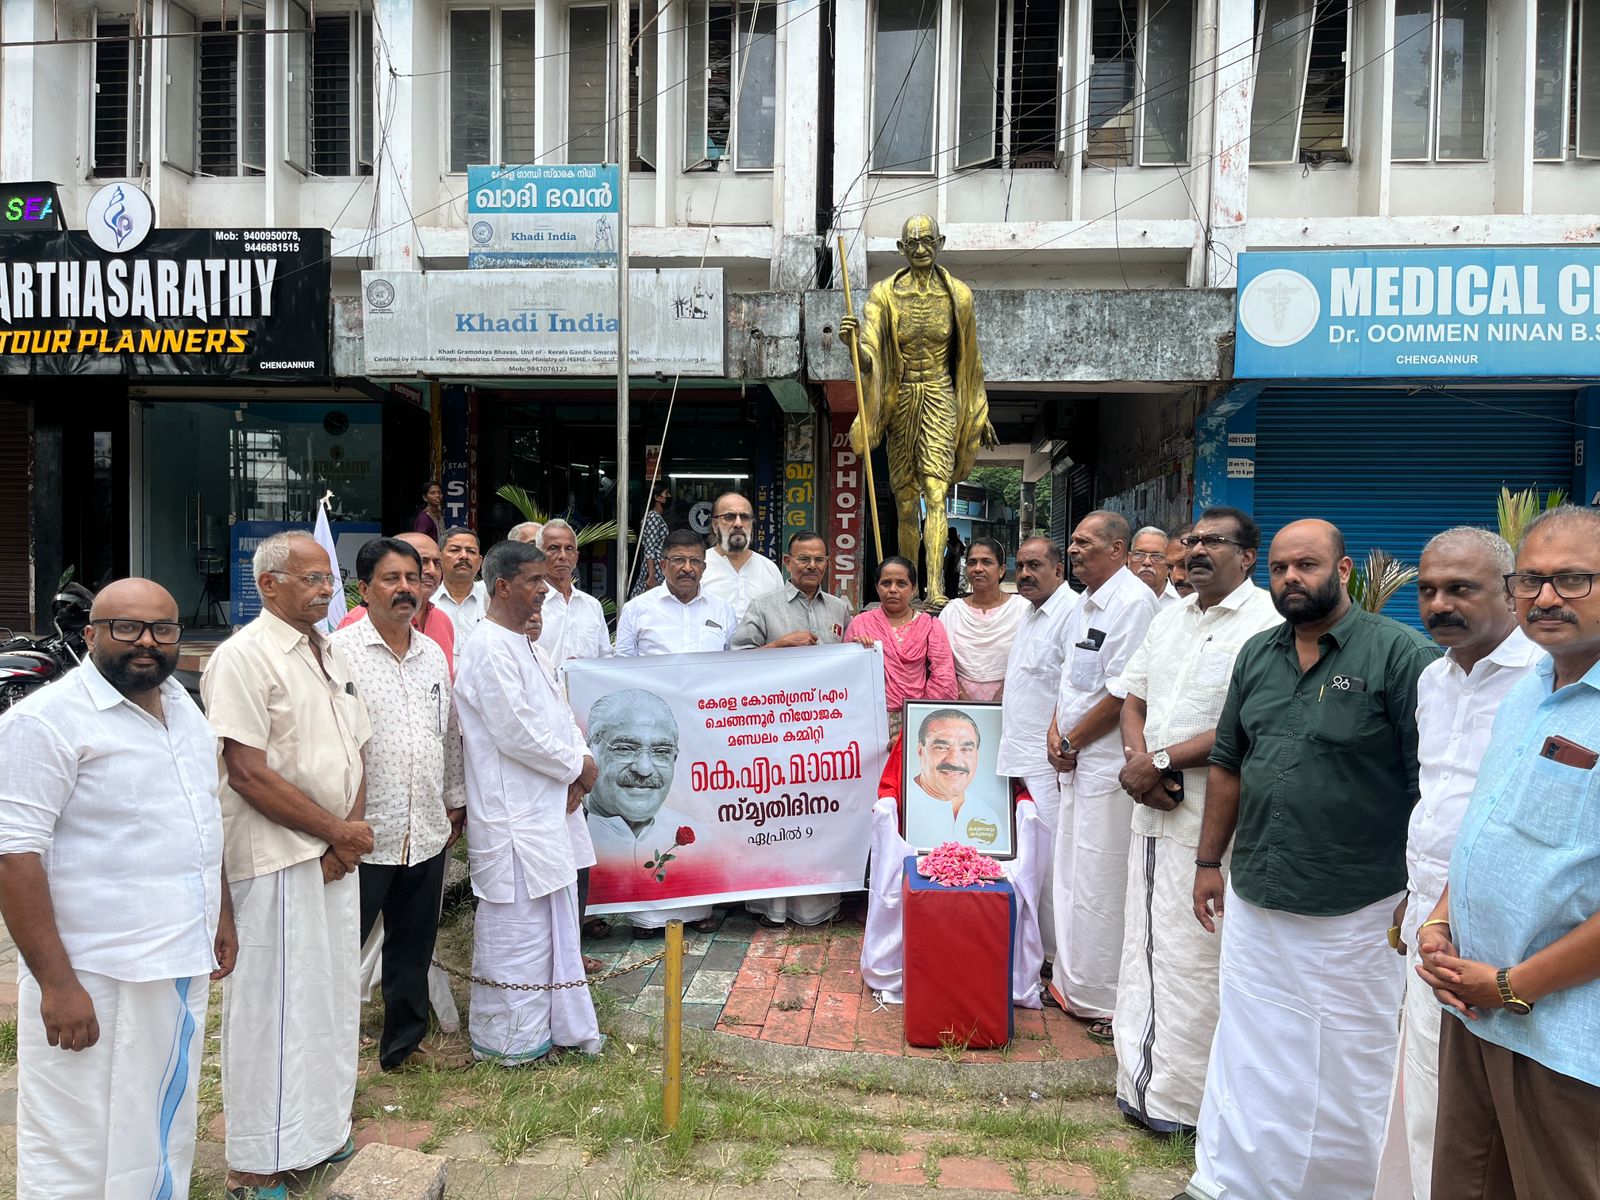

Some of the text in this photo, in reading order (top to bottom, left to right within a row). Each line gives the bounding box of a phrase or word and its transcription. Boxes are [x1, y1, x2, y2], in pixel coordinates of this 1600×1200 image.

[475, 181, 613, 208] ഖാദി ഭവൻ
[215, 231, 301, 243] Mob: 9400950078,
[510, 232, 577, 241] Khadi India
[244, 242, 300, 253] 9446681515
[1330, 265, 1546, 318] MEDICAL
[454, 312, 619, 333] Khadi India
[1328, 325, 1360, 344] Dr.
[1366, 323, 1480, 343] OOMMEN
[1488, 322, 1564, 342] NINAN
[0, 328, 250, 354] TOUR PLANNERS
[259, 359, 316, 370] CHENGANNUR
[1395, 353, 1479, 366] CHENGANNUR
[698, 688, 848, 711] കേരള കോൺഗ്രസ് (എം)
[705, 708, 843, 729] ചെങ്ങന്നൂർ നിയോജക
[727, 725, 825, 747] മണ്ഡലം കമ്മിറ്റി
[717, 791, 840, 827] സ്മൃതിദിനം
[747, 826, 813, 846] ഏപ്രിൽ 9
